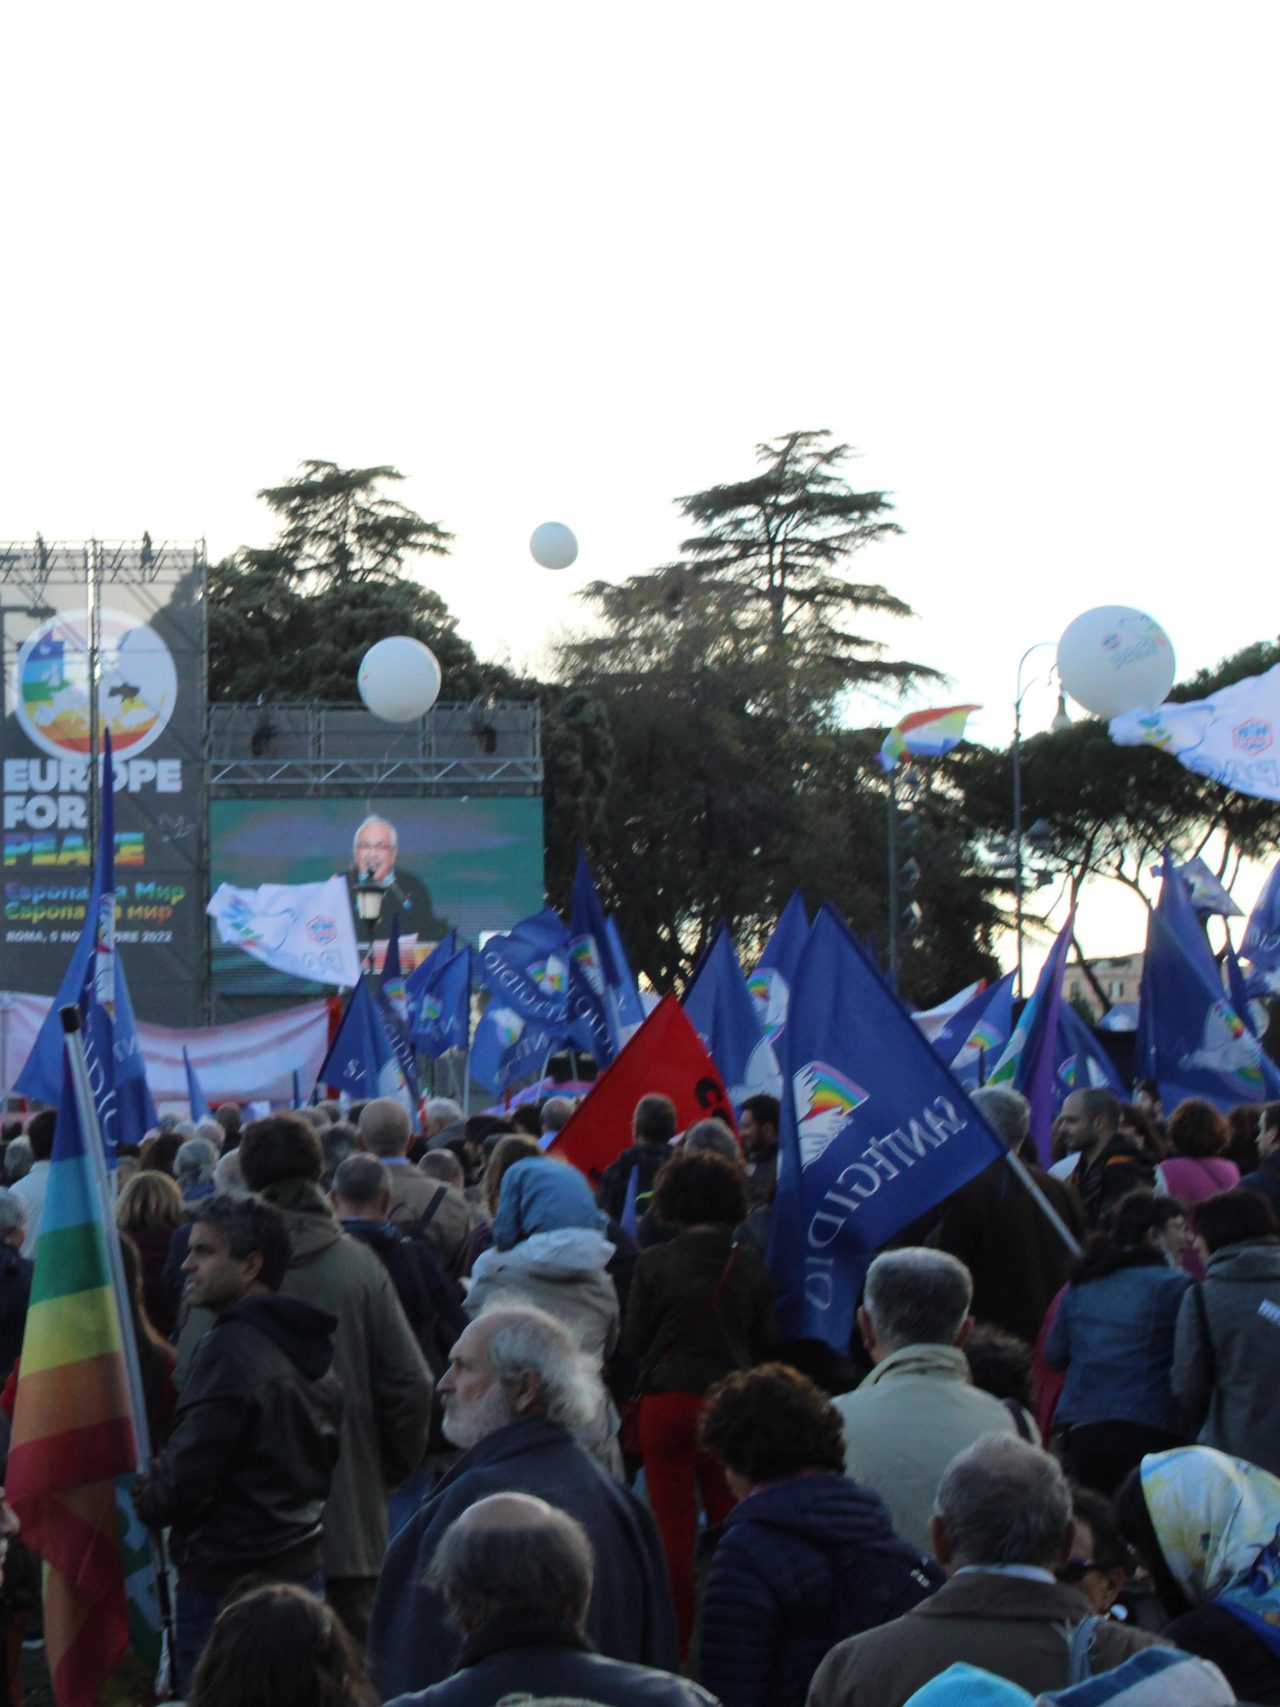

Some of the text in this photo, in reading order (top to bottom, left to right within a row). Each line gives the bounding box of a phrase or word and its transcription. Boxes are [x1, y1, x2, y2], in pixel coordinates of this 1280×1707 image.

[3, 758, 183, 793] EUROPE
[3, 794, 89, 830] FOR
[3, 832, 146, 866] PEAE
